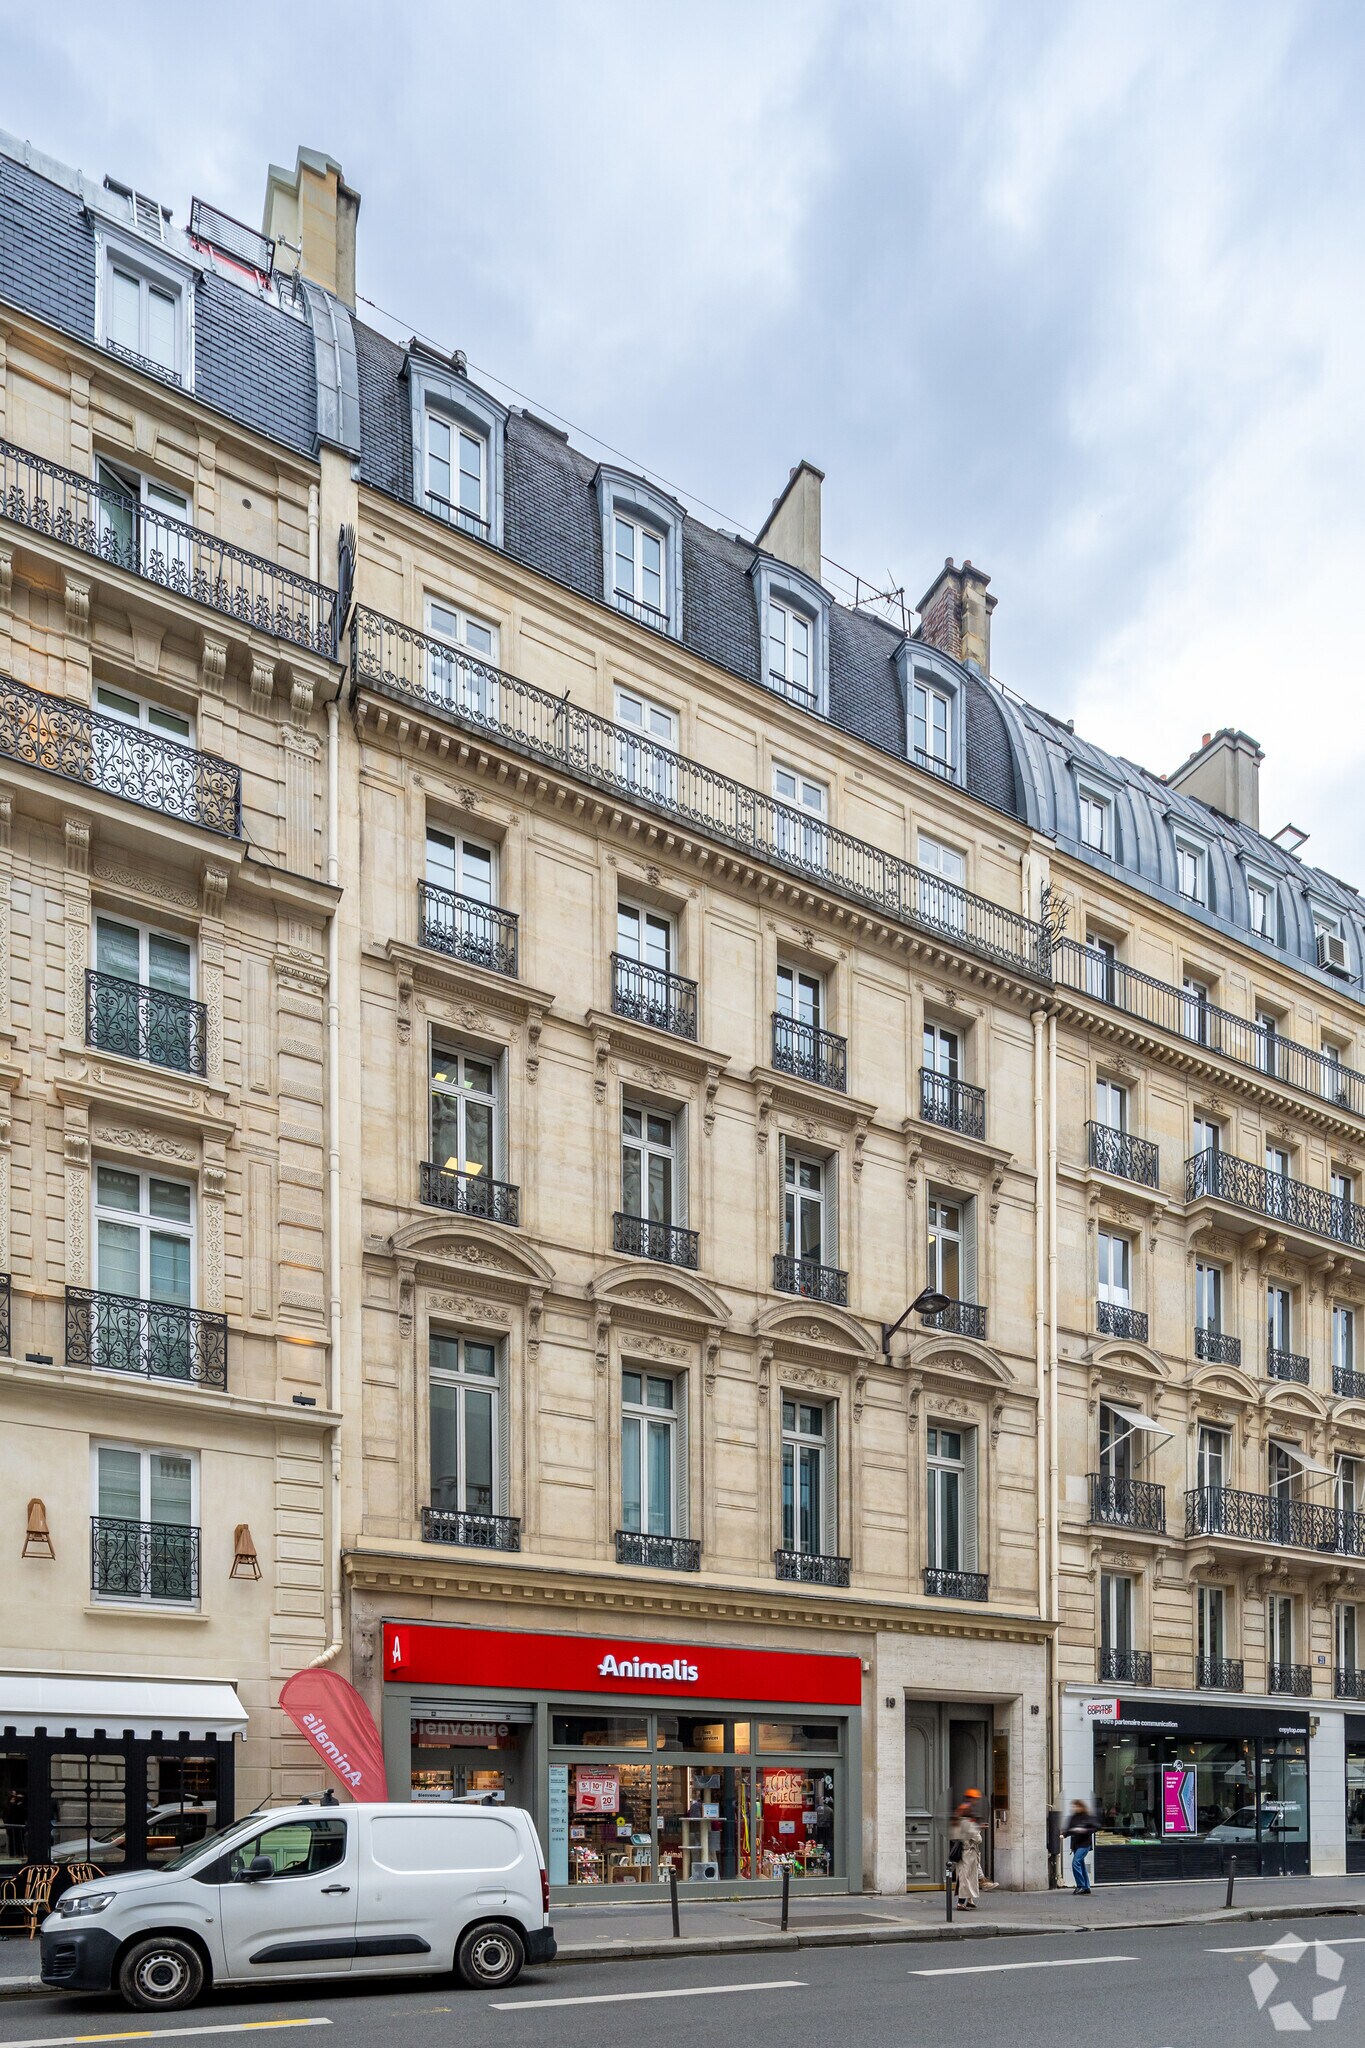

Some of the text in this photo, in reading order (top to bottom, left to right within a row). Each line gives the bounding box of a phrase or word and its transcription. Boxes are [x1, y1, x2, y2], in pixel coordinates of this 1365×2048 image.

[597, 1654, 699, 1682] Animalis
[886, 1697, 896, 1708] 19
[1030, 1705, 1039, 1715] 19
[411, 1719, 509, 1737] Bienvenue
[1141, 1720, 1179, 1728] communication
